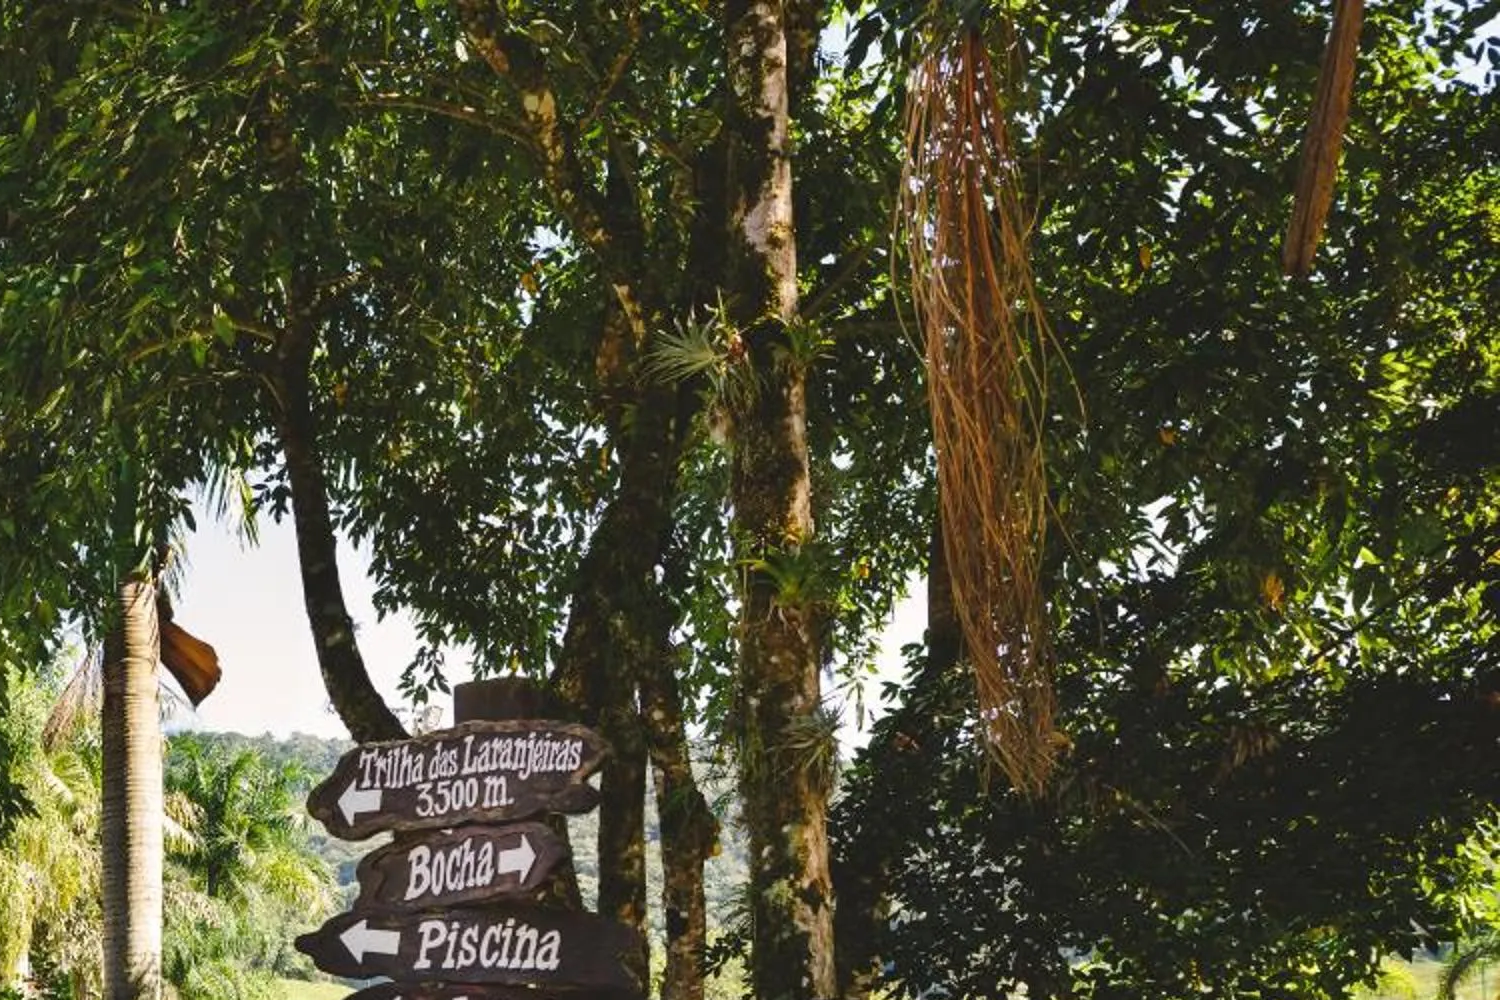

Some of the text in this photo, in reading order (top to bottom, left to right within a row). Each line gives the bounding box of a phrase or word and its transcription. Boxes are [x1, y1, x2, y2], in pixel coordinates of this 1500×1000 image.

[360, 731, 583, 789] Trilha das Laranjeiras
[481, 774, 516, 808] m.
[404, 838, 496, 901] Bocha
[413, 917, 561, 971] Piscina
